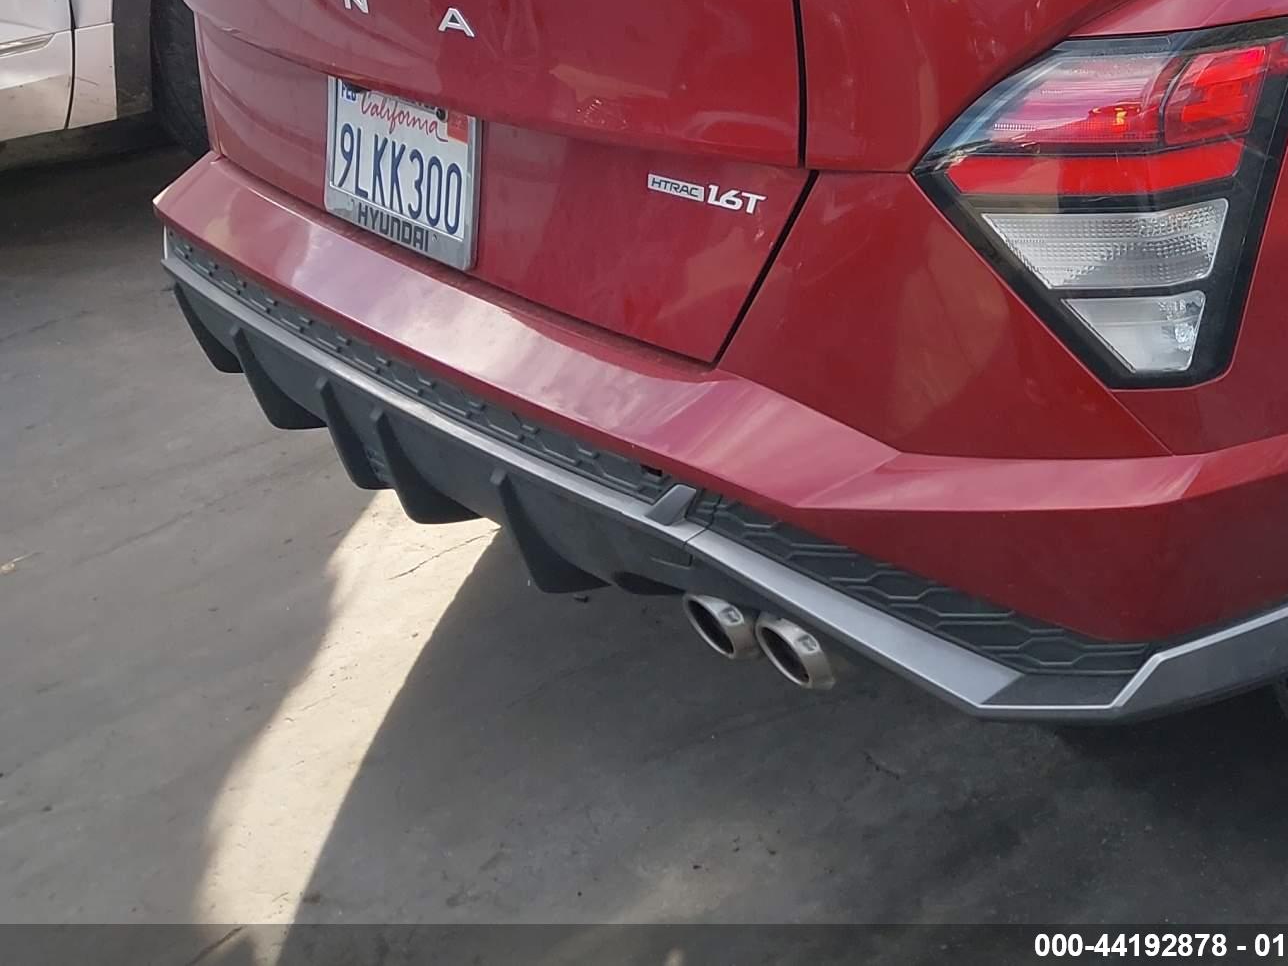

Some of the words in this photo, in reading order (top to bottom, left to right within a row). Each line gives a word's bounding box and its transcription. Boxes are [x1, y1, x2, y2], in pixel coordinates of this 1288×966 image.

[360, 91, 449, 143] California
[338, 122, 463, 235] 9LKK300
[650, 177, 700, 198] HTRAC
[357, 200, 429, 253] HYUNDAI
